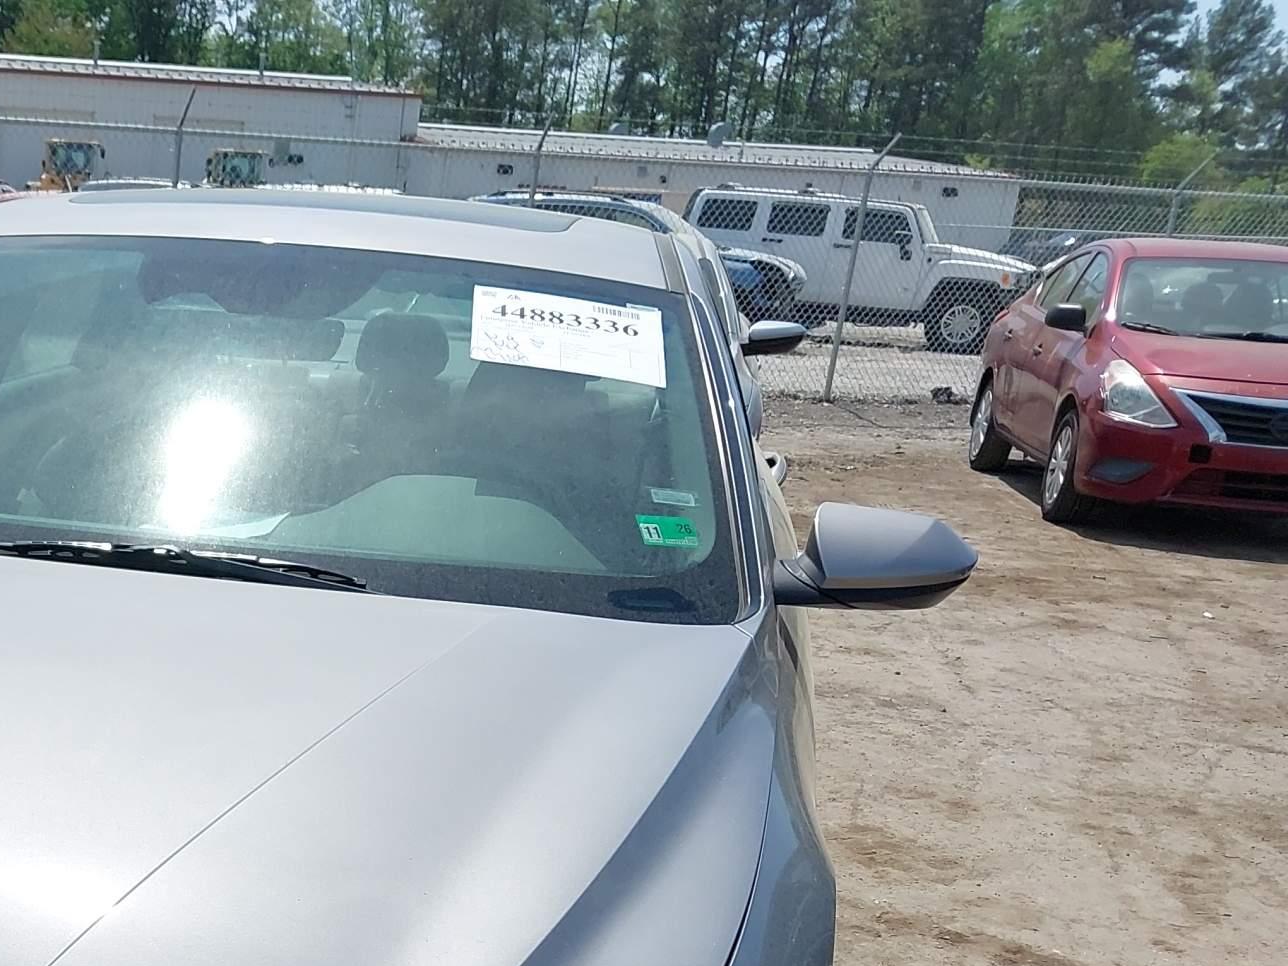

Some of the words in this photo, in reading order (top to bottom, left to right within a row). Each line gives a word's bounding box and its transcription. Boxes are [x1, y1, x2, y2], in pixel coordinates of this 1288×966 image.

[492, 304, 639, 337] 44883336
[643, 526, 661, 539] 11
[676, 523, 693, 535] 26
